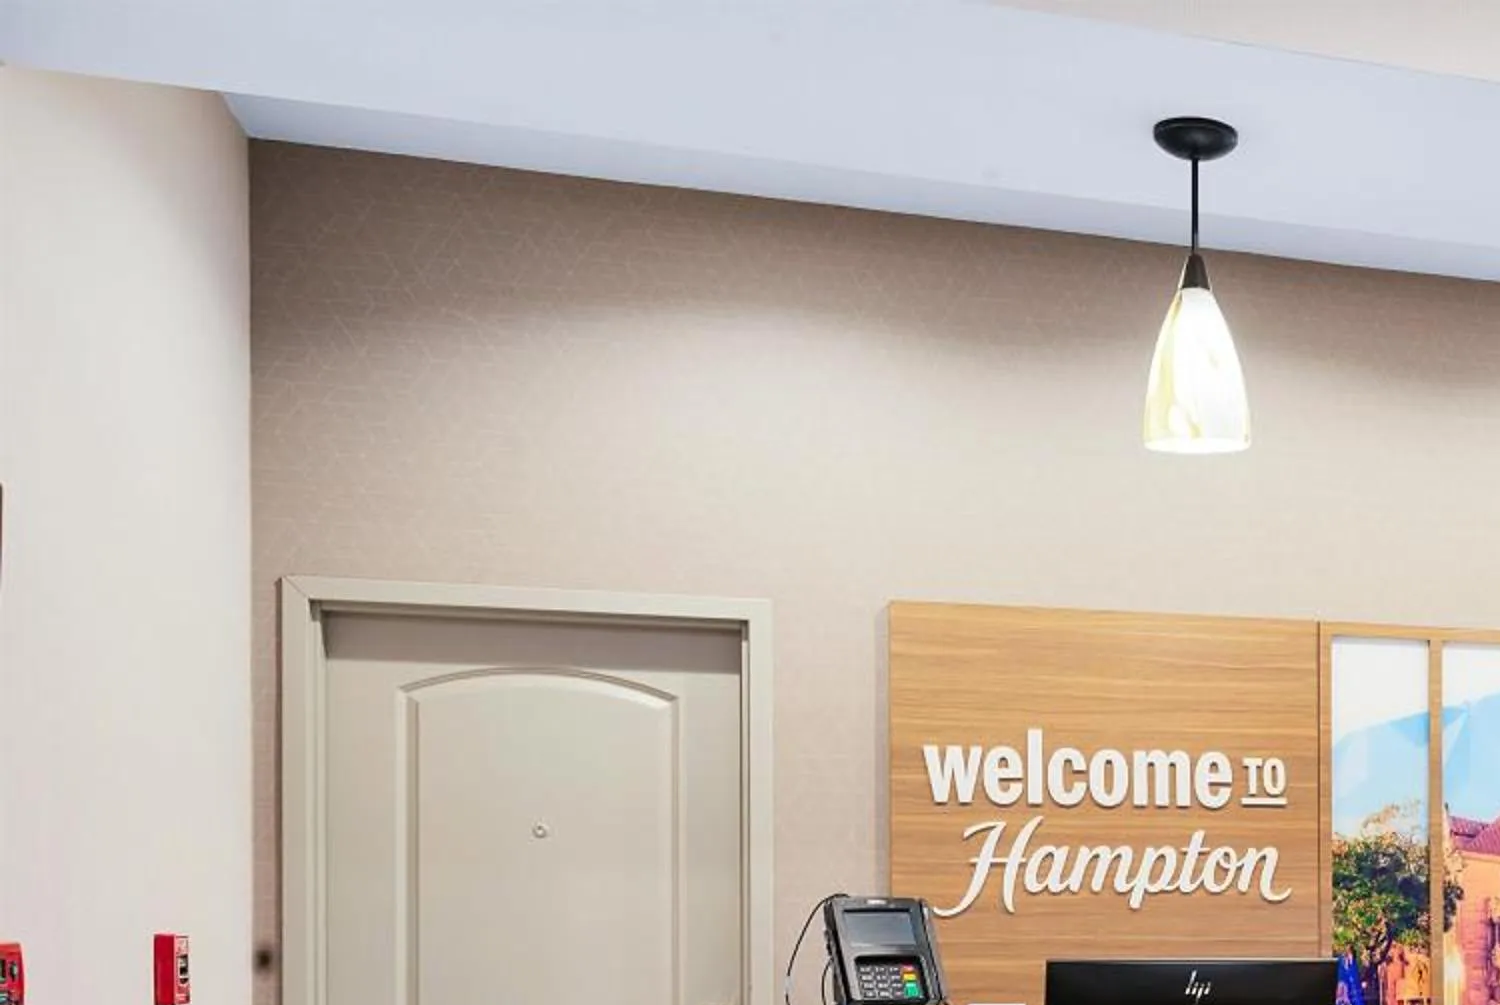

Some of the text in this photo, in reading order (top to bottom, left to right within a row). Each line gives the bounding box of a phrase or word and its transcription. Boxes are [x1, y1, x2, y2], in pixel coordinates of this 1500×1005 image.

[922, 728, 1287, 808] welcome TO
[932, 816, 1292, 917] Hampton
